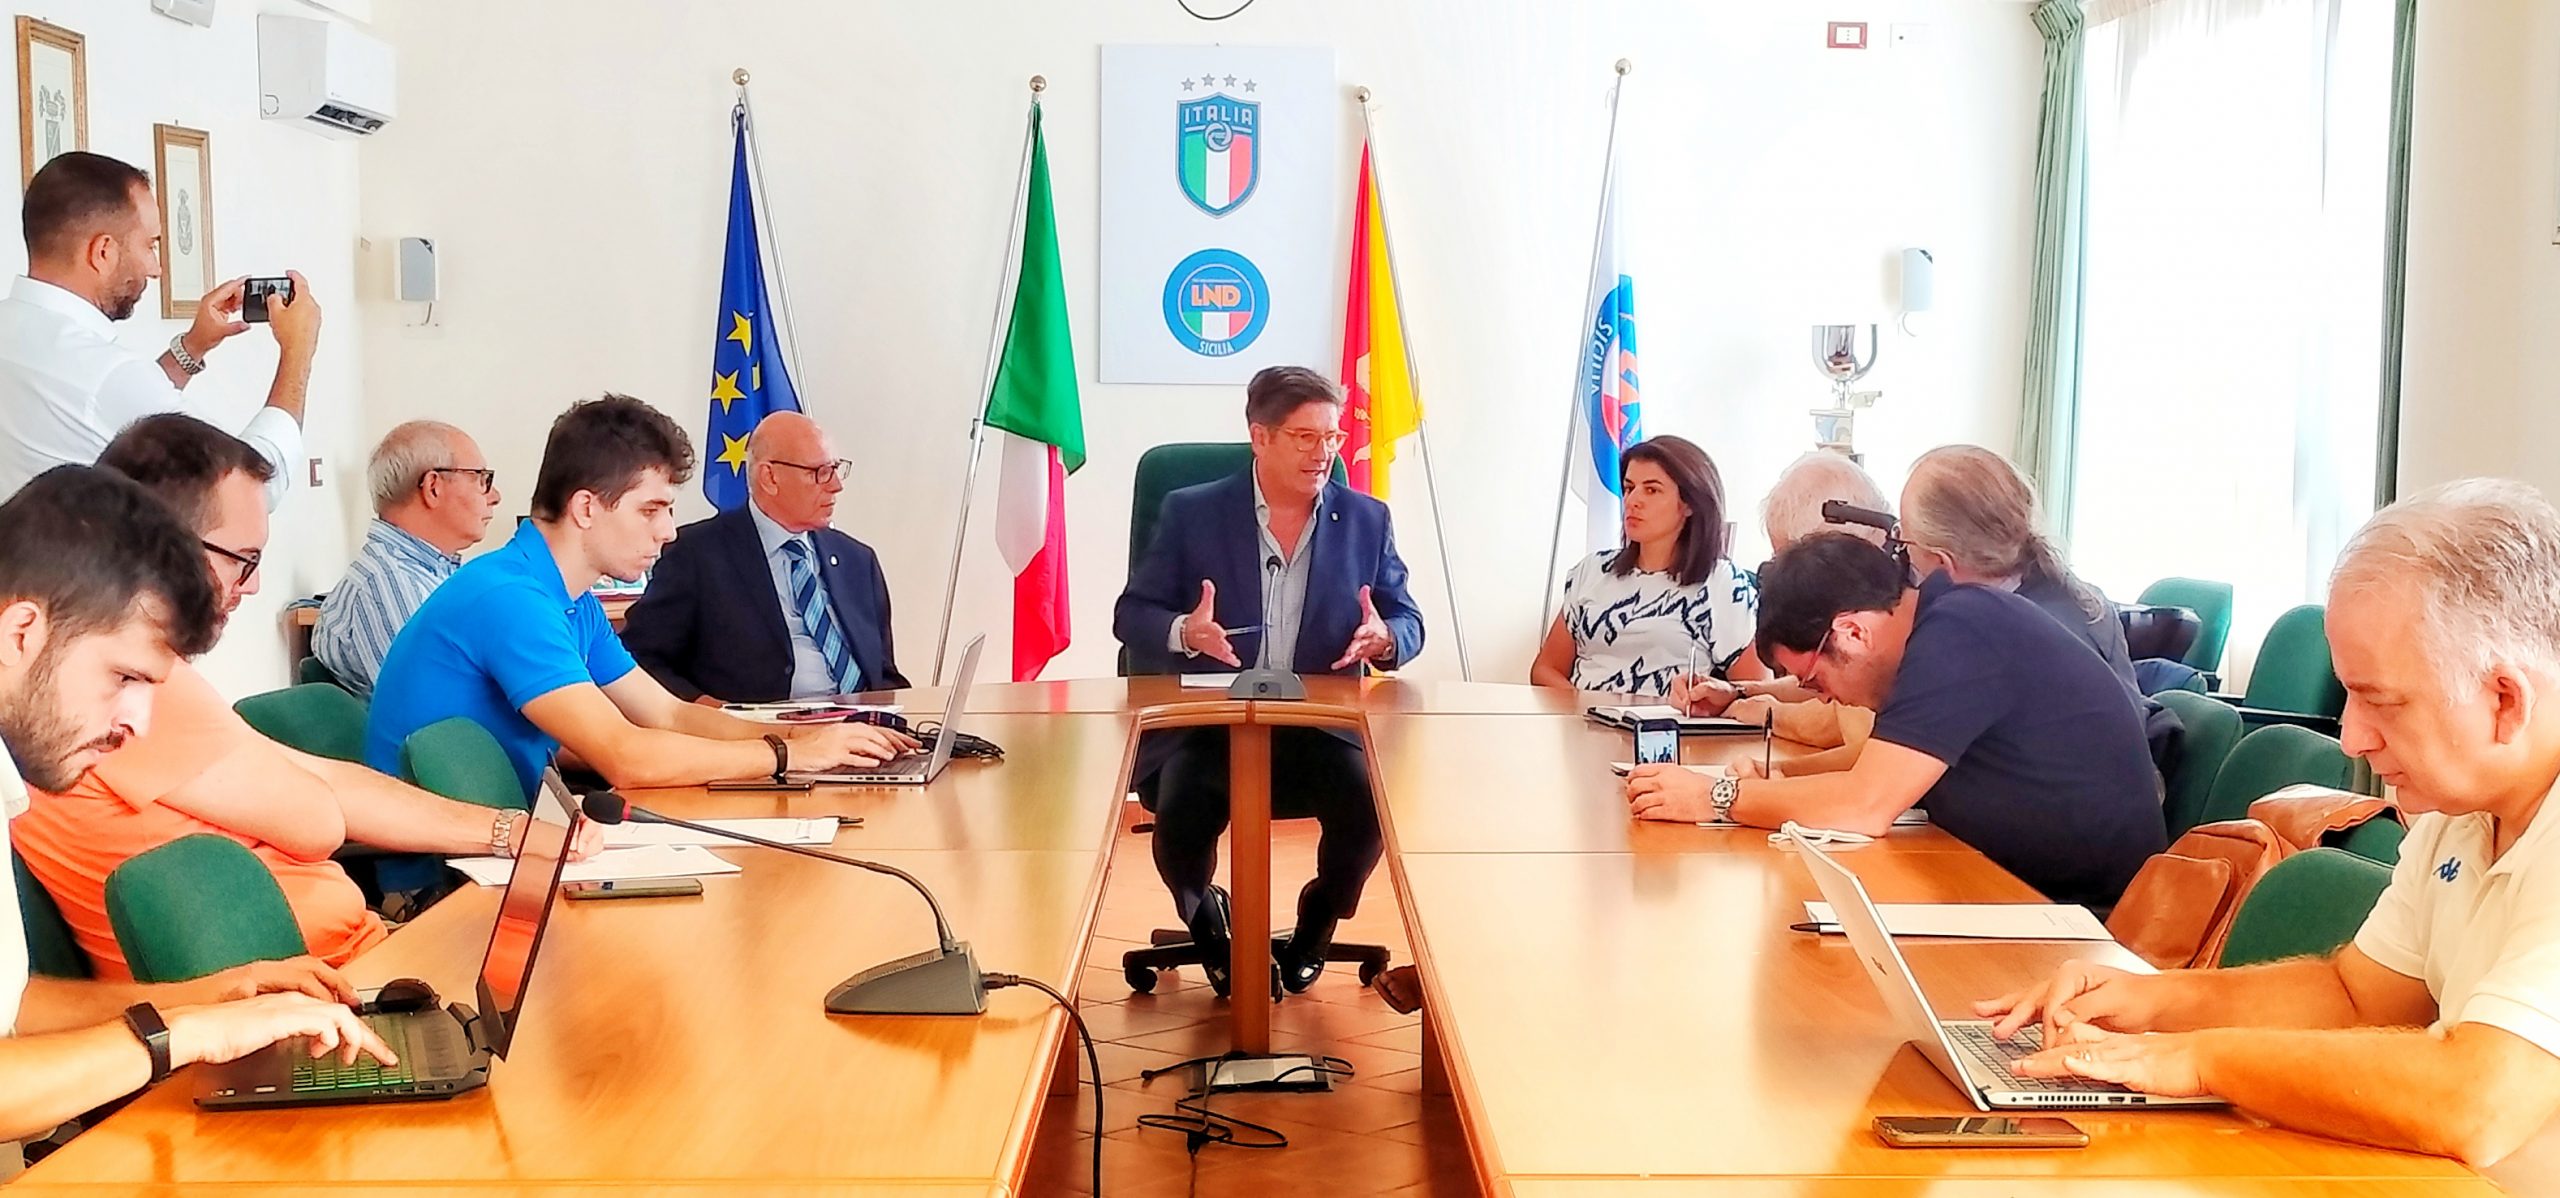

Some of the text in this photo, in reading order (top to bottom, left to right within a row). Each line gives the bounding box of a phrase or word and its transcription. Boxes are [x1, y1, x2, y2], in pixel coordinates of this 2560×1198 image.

[1184, 105, 1253, 126] ITALIA
[1191, 283, 1241, 309] LND
[1198, 341, 1235, 355] SICILIA
